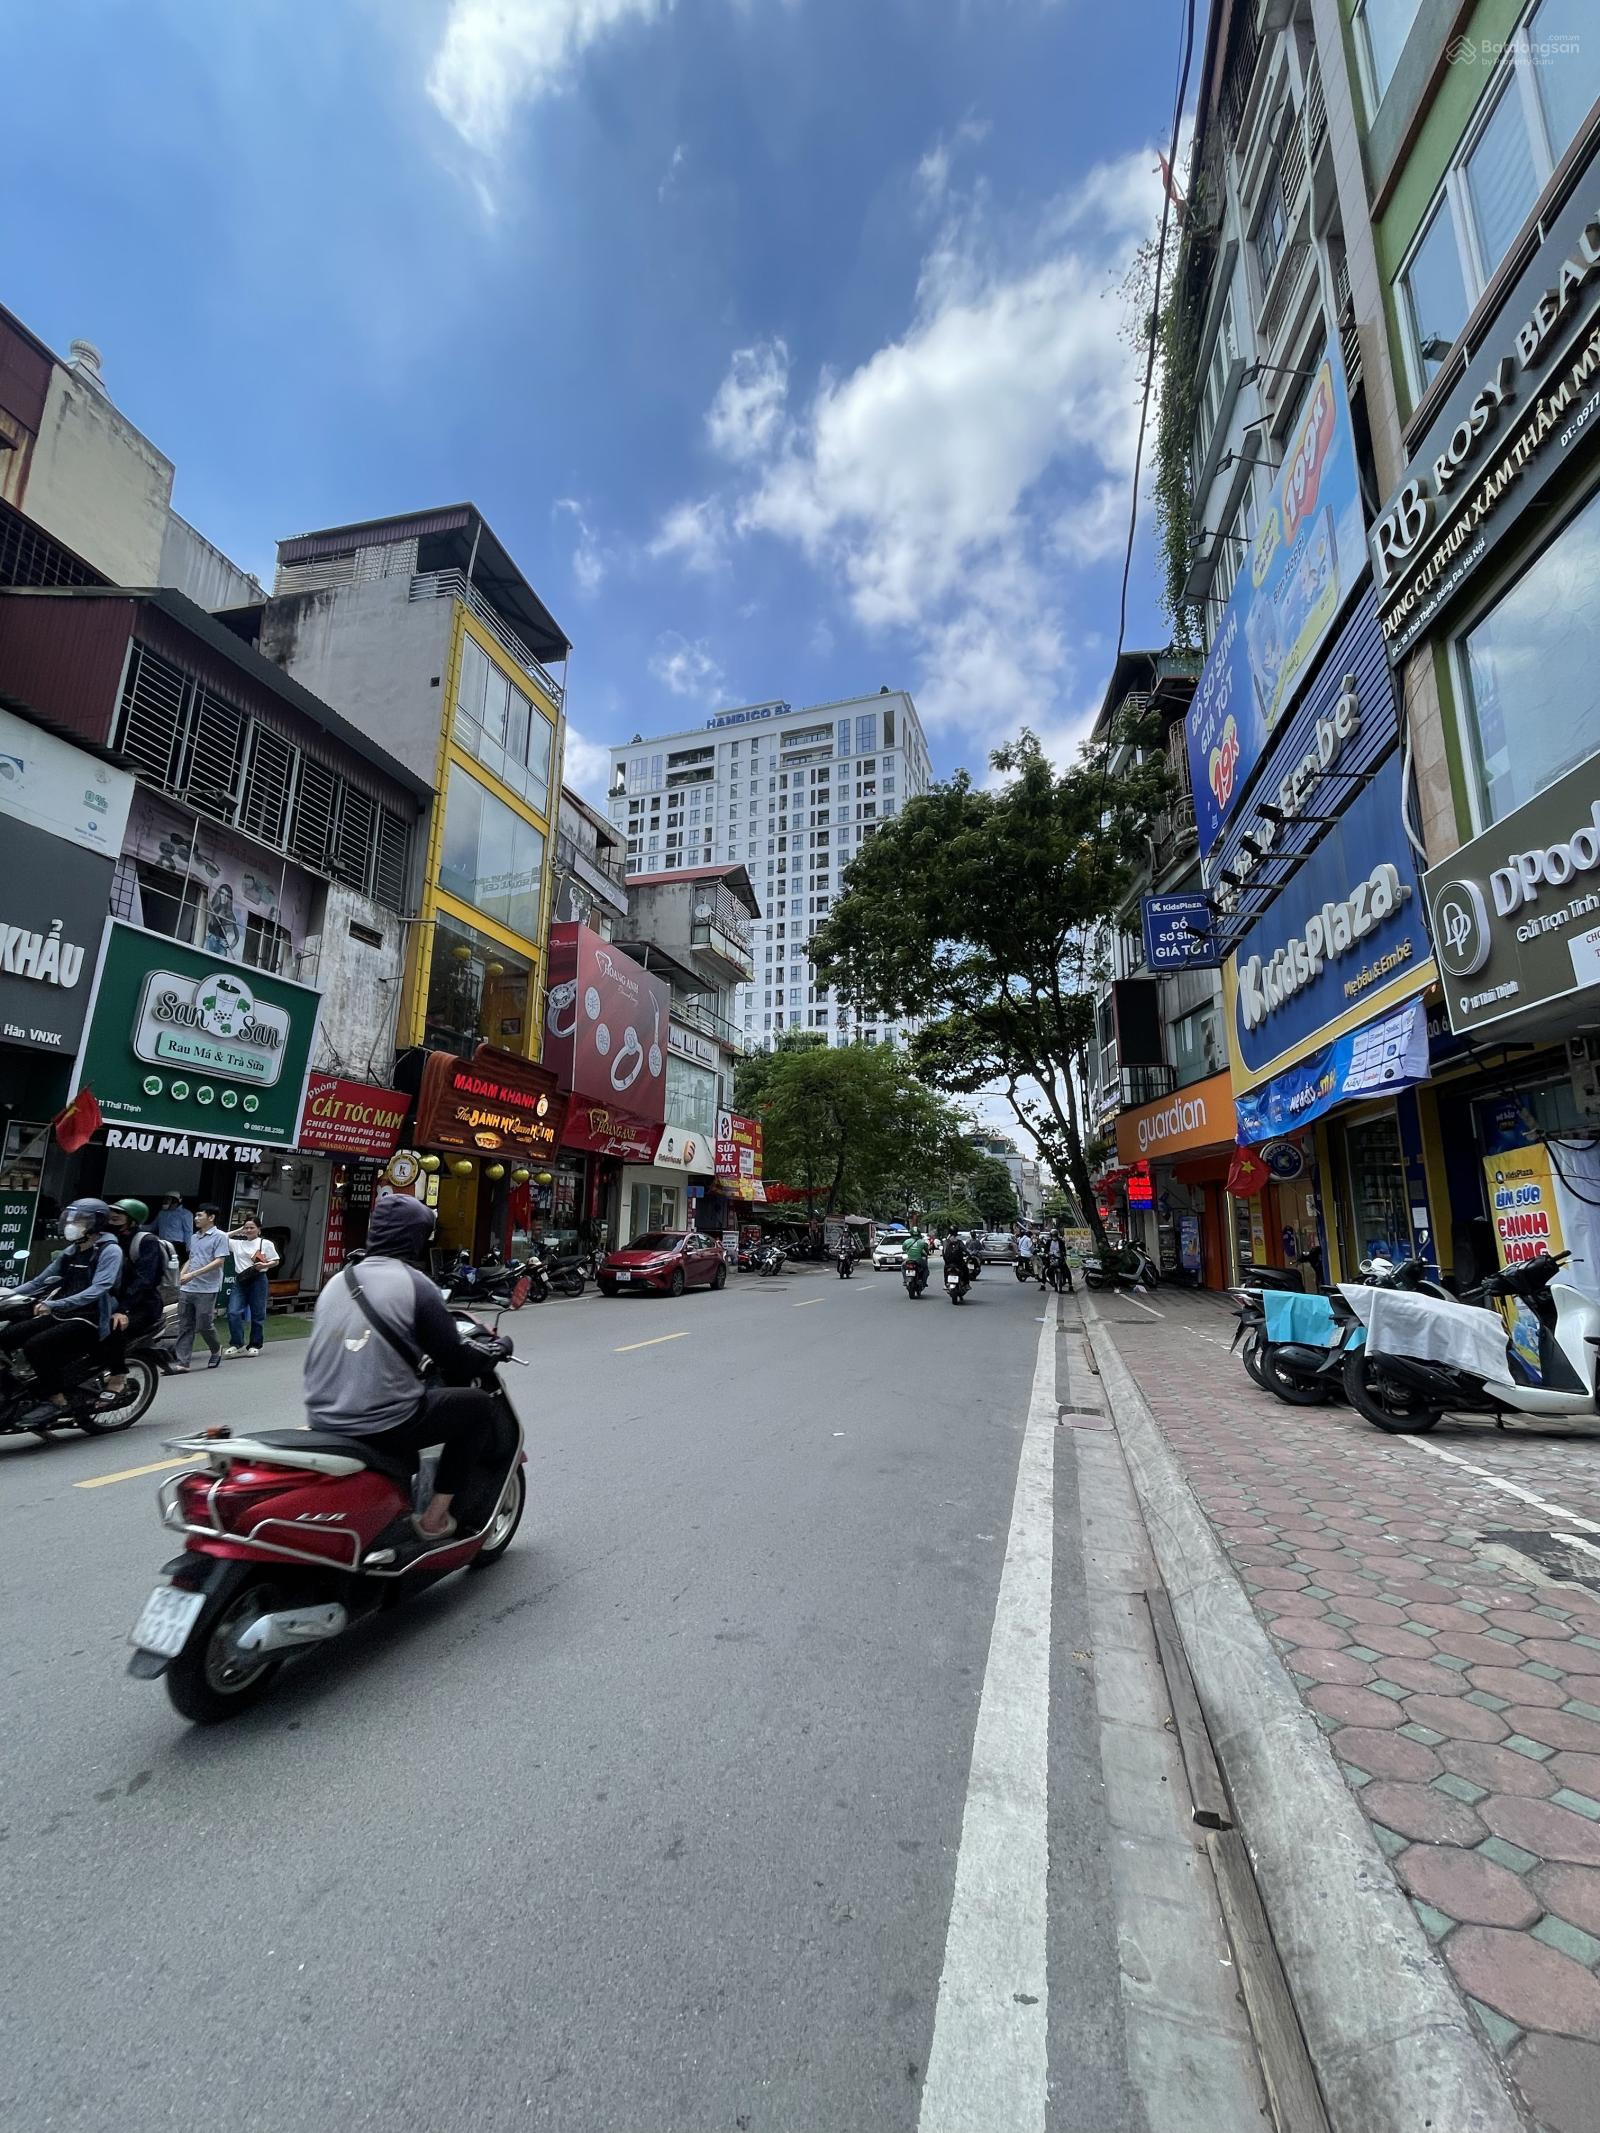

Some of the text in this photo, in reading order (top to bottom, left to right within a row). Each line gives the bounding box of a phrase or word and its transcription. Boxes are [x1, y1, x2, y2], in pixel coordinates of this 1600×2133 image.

[1372, 479, 1434, 589] RB
[1432, 356, 1512, 494] ROSY
[1382, 589, 1415, 640] DỤNG
[1415, 563, 1435, 597] CỤ
[1432, 511, 1473, 574] PHUN
[1471, 462, 1513, 523] XĂM
[1511, 398, 1572, 468] THẨM
[1408, 618, 1421, 636] Thái
[1463, 553, 1473, 570] Hà
[1472, 537, 1485, 558] Nội
[1214, 609, 1239, 680] SINH
[707, 708, 771, 729] HANDICO
[1201, 704, 1216, 755] GIÁ
[1215, 666, 1234, 719] TỐT
[1316, 673, 1361, 768] bé
[1214, 724, 1240, 808] 19K
[1163, 903, 1202, 912] KidsPlaza
[1538, 909, 1570, 932] Trọn
[1160, 931, 1175, 942] SƠ
[1262, 862, 1402, 1013] KidsPlaza
[1155, 943, 1181, 957] GIÁ
[1379, 953, 1397, 974] Em
[1396, 938, 1413, 964] bé
[627, 978, 639, 993] ANH
[156, 990, 209, 1030] San
[30, 1029, 62, 1046] VNXK
[238, 1014, 284, 1050] San
[168, 1039, 265, 1072] Rau Má & Trà Sữa
[454, 1073, 537, 1109] MADAM KHANH
[106, 1100, 122, 1109] Thái
[312, 1094, 404, 1130] CẮT TÓC NAM
[455, 1106, 471, 1121] The
[469, 1108, 501, 1128] BÁNH
[1138, 1097, 1207, 1152] guardian
[334, 1134, 347, 1142] TAI
[348, 1137, 370, 1146] NÓNG
[621, 1129, 637, 1141] ANH
[106, 1130, 263, 1164] RAU MÁ MIX 15K
[717, 1142, 736, 1153] SỬA
[720, 1154, 733, 1162] XE
[716, 1163, 737, 1173] MÁY
[1505, 1168, 1534, 1180] KidsPlaza
[4, 1204, 28, 1215] 100%
[351, 1194, 370, 1202] NAM
[1, 1223, 21, 1233] RAU
[1497, 1210, 1548, 1237] CHÍNH
